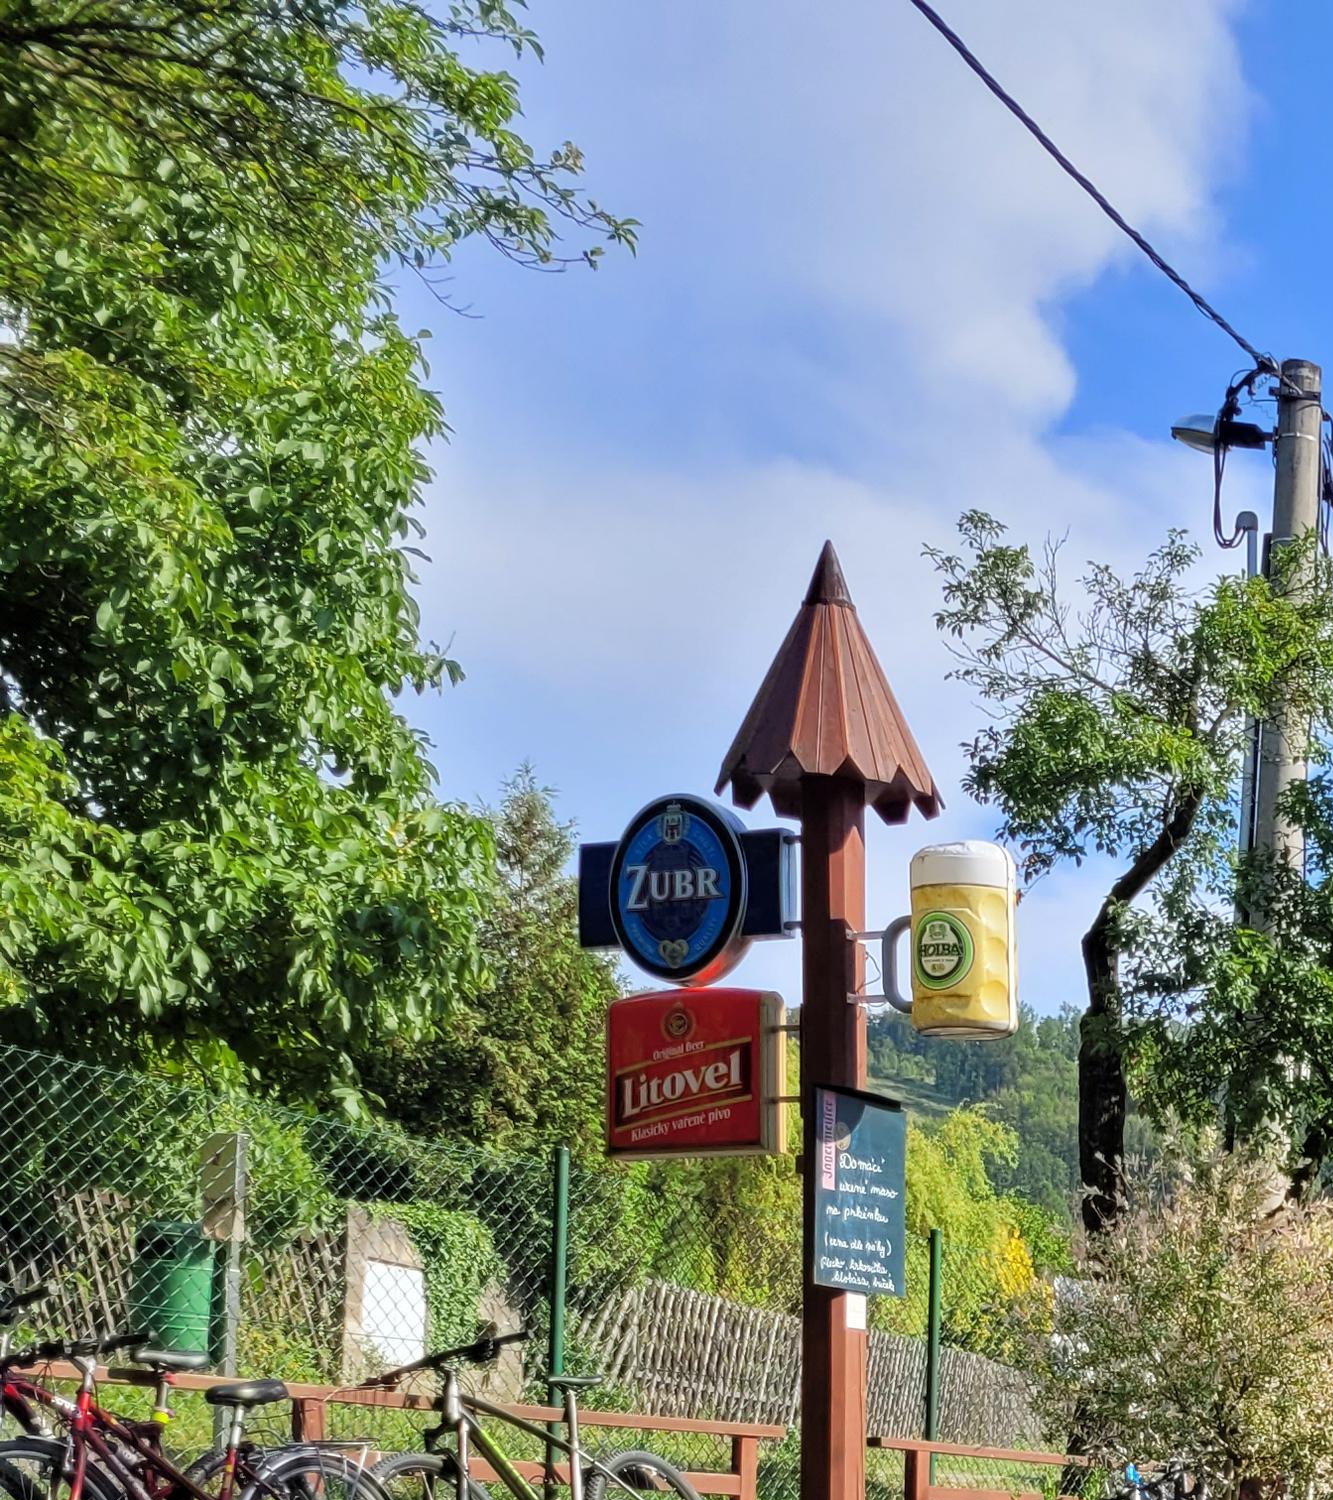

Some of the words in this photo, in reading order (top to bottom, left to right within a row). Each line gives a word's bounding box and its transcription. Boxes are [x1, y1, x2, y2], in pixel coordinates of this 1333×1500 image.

[626, 865, 725, 911] ZUBR
[919, 943, 963, 957] HOLBA
[622, 1050, 742, 1118] Litovel
[708, 1108, 731, 1126] pivo
[870, 1185, 899, 1199] maso
